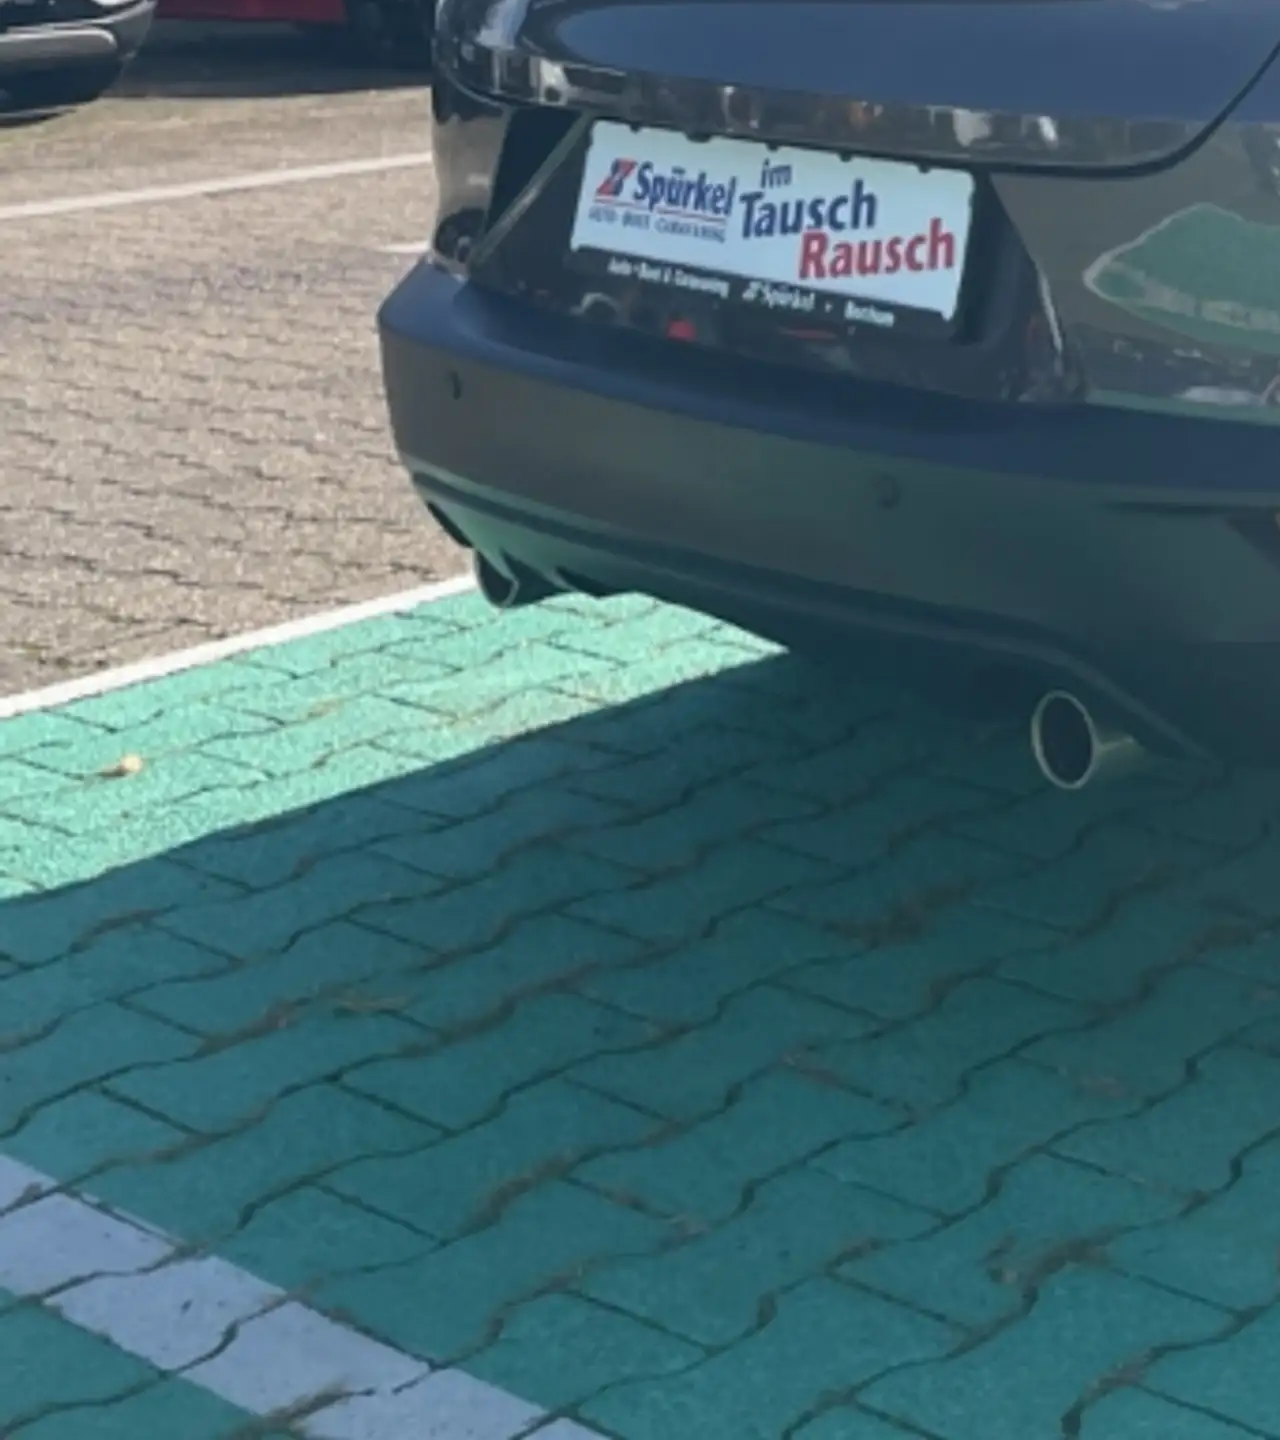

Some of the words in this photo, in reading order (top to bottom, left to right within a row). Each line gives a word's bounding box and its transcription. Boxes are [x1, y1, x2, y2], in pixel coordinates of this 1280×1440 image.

[633, 159, 738, 216] Spürkel
[761, 157, 794, 189] im
[739, 177, 877, 239] Tausch
[796, 216, 955, 280] Rausch
